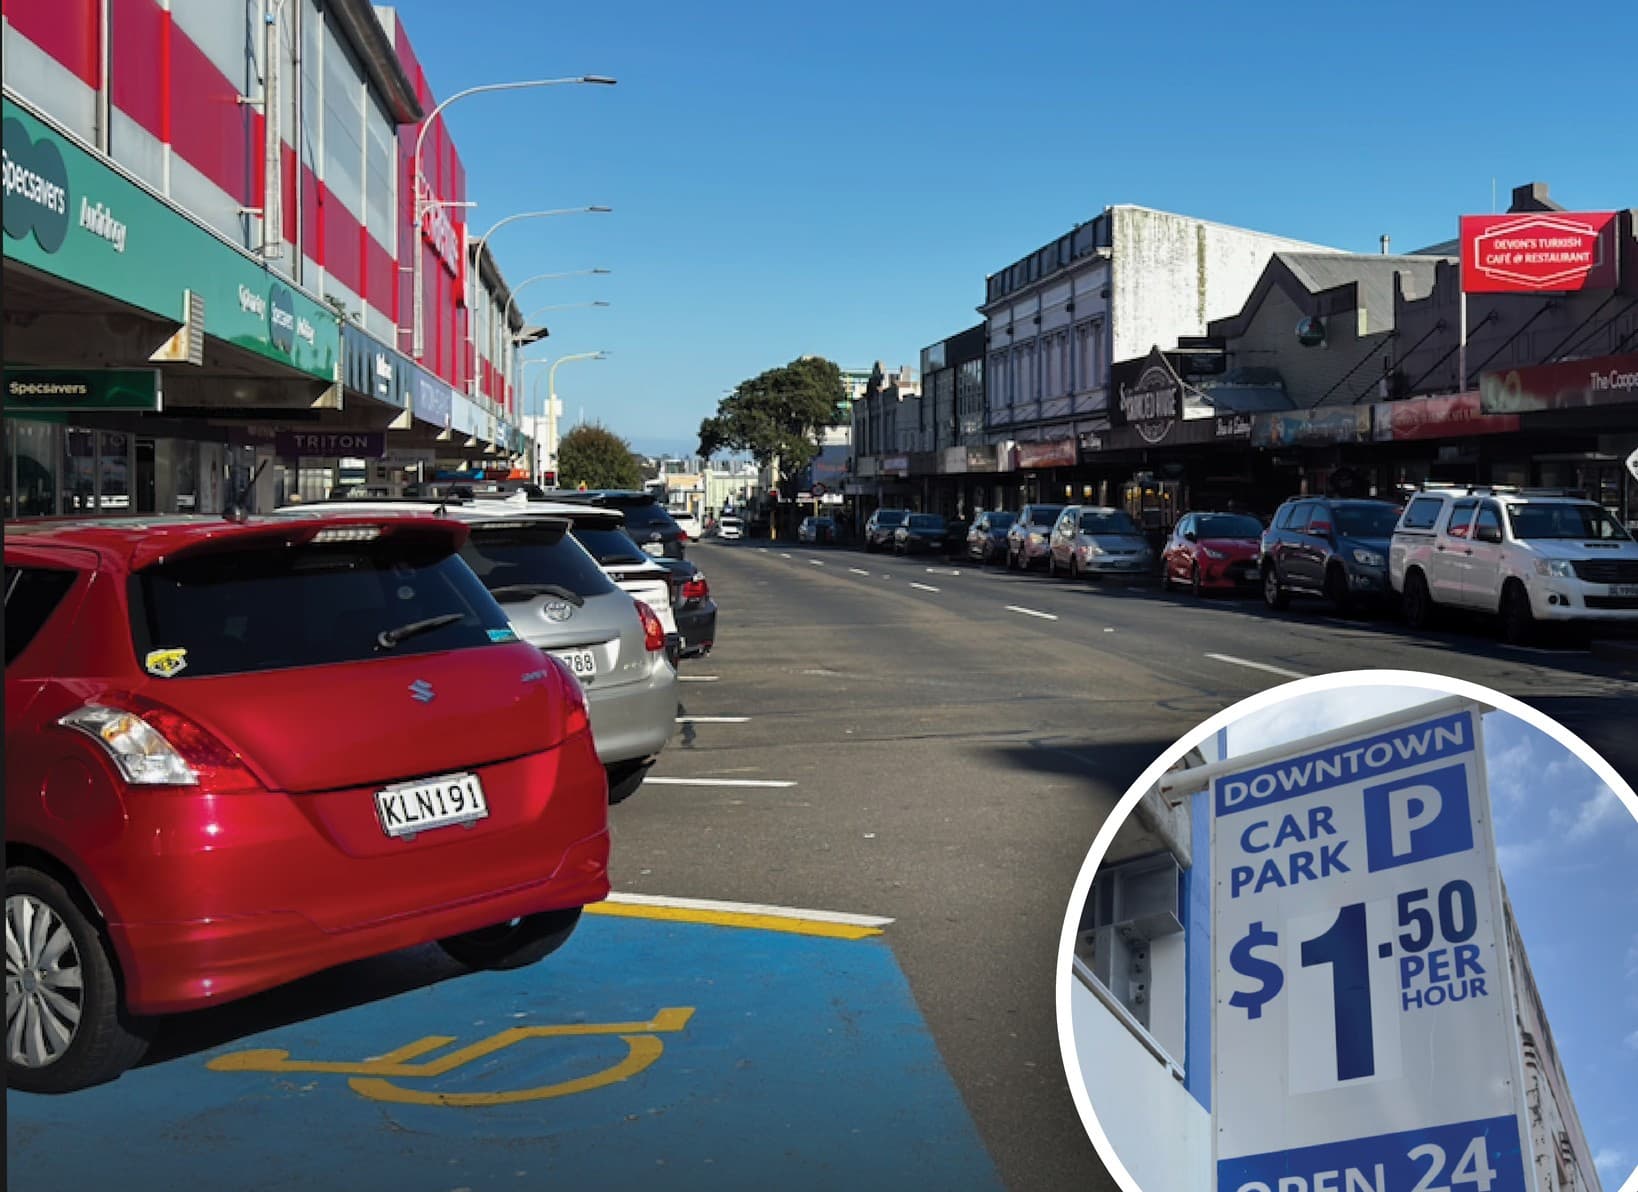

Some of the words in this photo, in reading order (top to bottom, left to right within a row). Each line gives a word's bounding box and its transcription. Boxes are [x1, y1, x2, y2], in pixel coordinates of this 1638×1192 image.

[1525, 252, 1590, 263] RESTAURANT
[1540, 237, 1582, 248] TURKISH
[9, 381, 87, 395] Specsavers
[1590, 371, 1609, 390] The
[293, 435, 367, 448] TRITON
[1224, 721, 1464, 807] DOWNTOWN
[382, 781, 480, 826] KLN191
[1240, 805, 1337, 854] CAR
[1231, 839, 1352, 899] PARK
[1399, 943, 1487, 990] PER
[1401, 977, 1489, 1012] HOUR
[1406, 1136, 1498, 1192] 24
